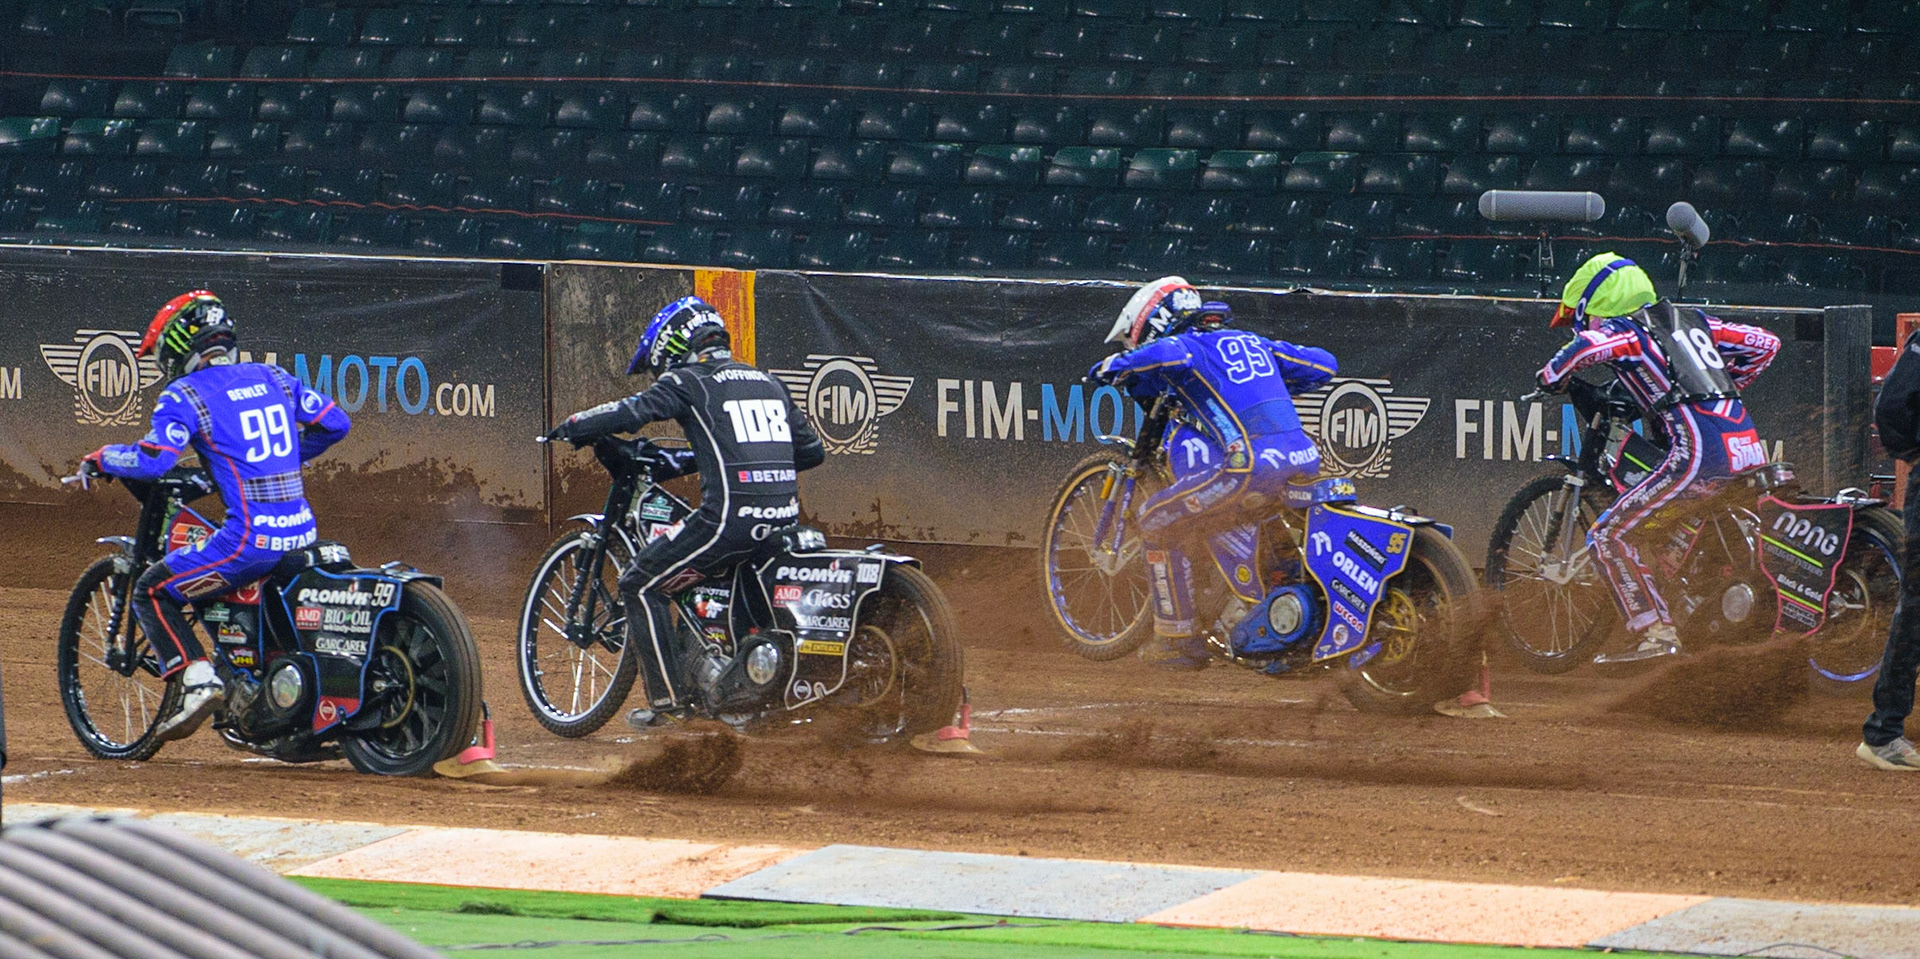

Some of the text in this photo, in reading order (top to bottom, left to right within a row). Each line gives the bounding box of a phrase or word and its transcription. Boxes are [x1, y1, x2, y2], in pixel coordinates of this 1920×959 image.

[1671, 328, 1725, 370] 18
[1744, 333, 1779, 351] GREA
[1215, 335, 1275, 385] 95
[86, 358, 131, 398] FIM
[712, 368, 770, 383] WOFFINDE
[226, 384, 268, 401] BEWLEY
[818, 386, 867, 425] FIM
[239, 403, 293, 463] 99
[722, 399, 792, 443] 108
[1330, 410, 1379, 449] FIM
[1288, 445, 1320, 466] ORLEN
[1728, 435, 1766, 471] STAR
[856, 563, 880, 583] 108
[1332, 551, 1380, 596] ORLEN
[370, 583, 395, 607] 99
[775, 587, 801, 600] AMD
[297, 609, 321, 621] AMD
[324, 608, 372, 626] BIO OIL
[796, 615, 851, 629] ARCAREK
